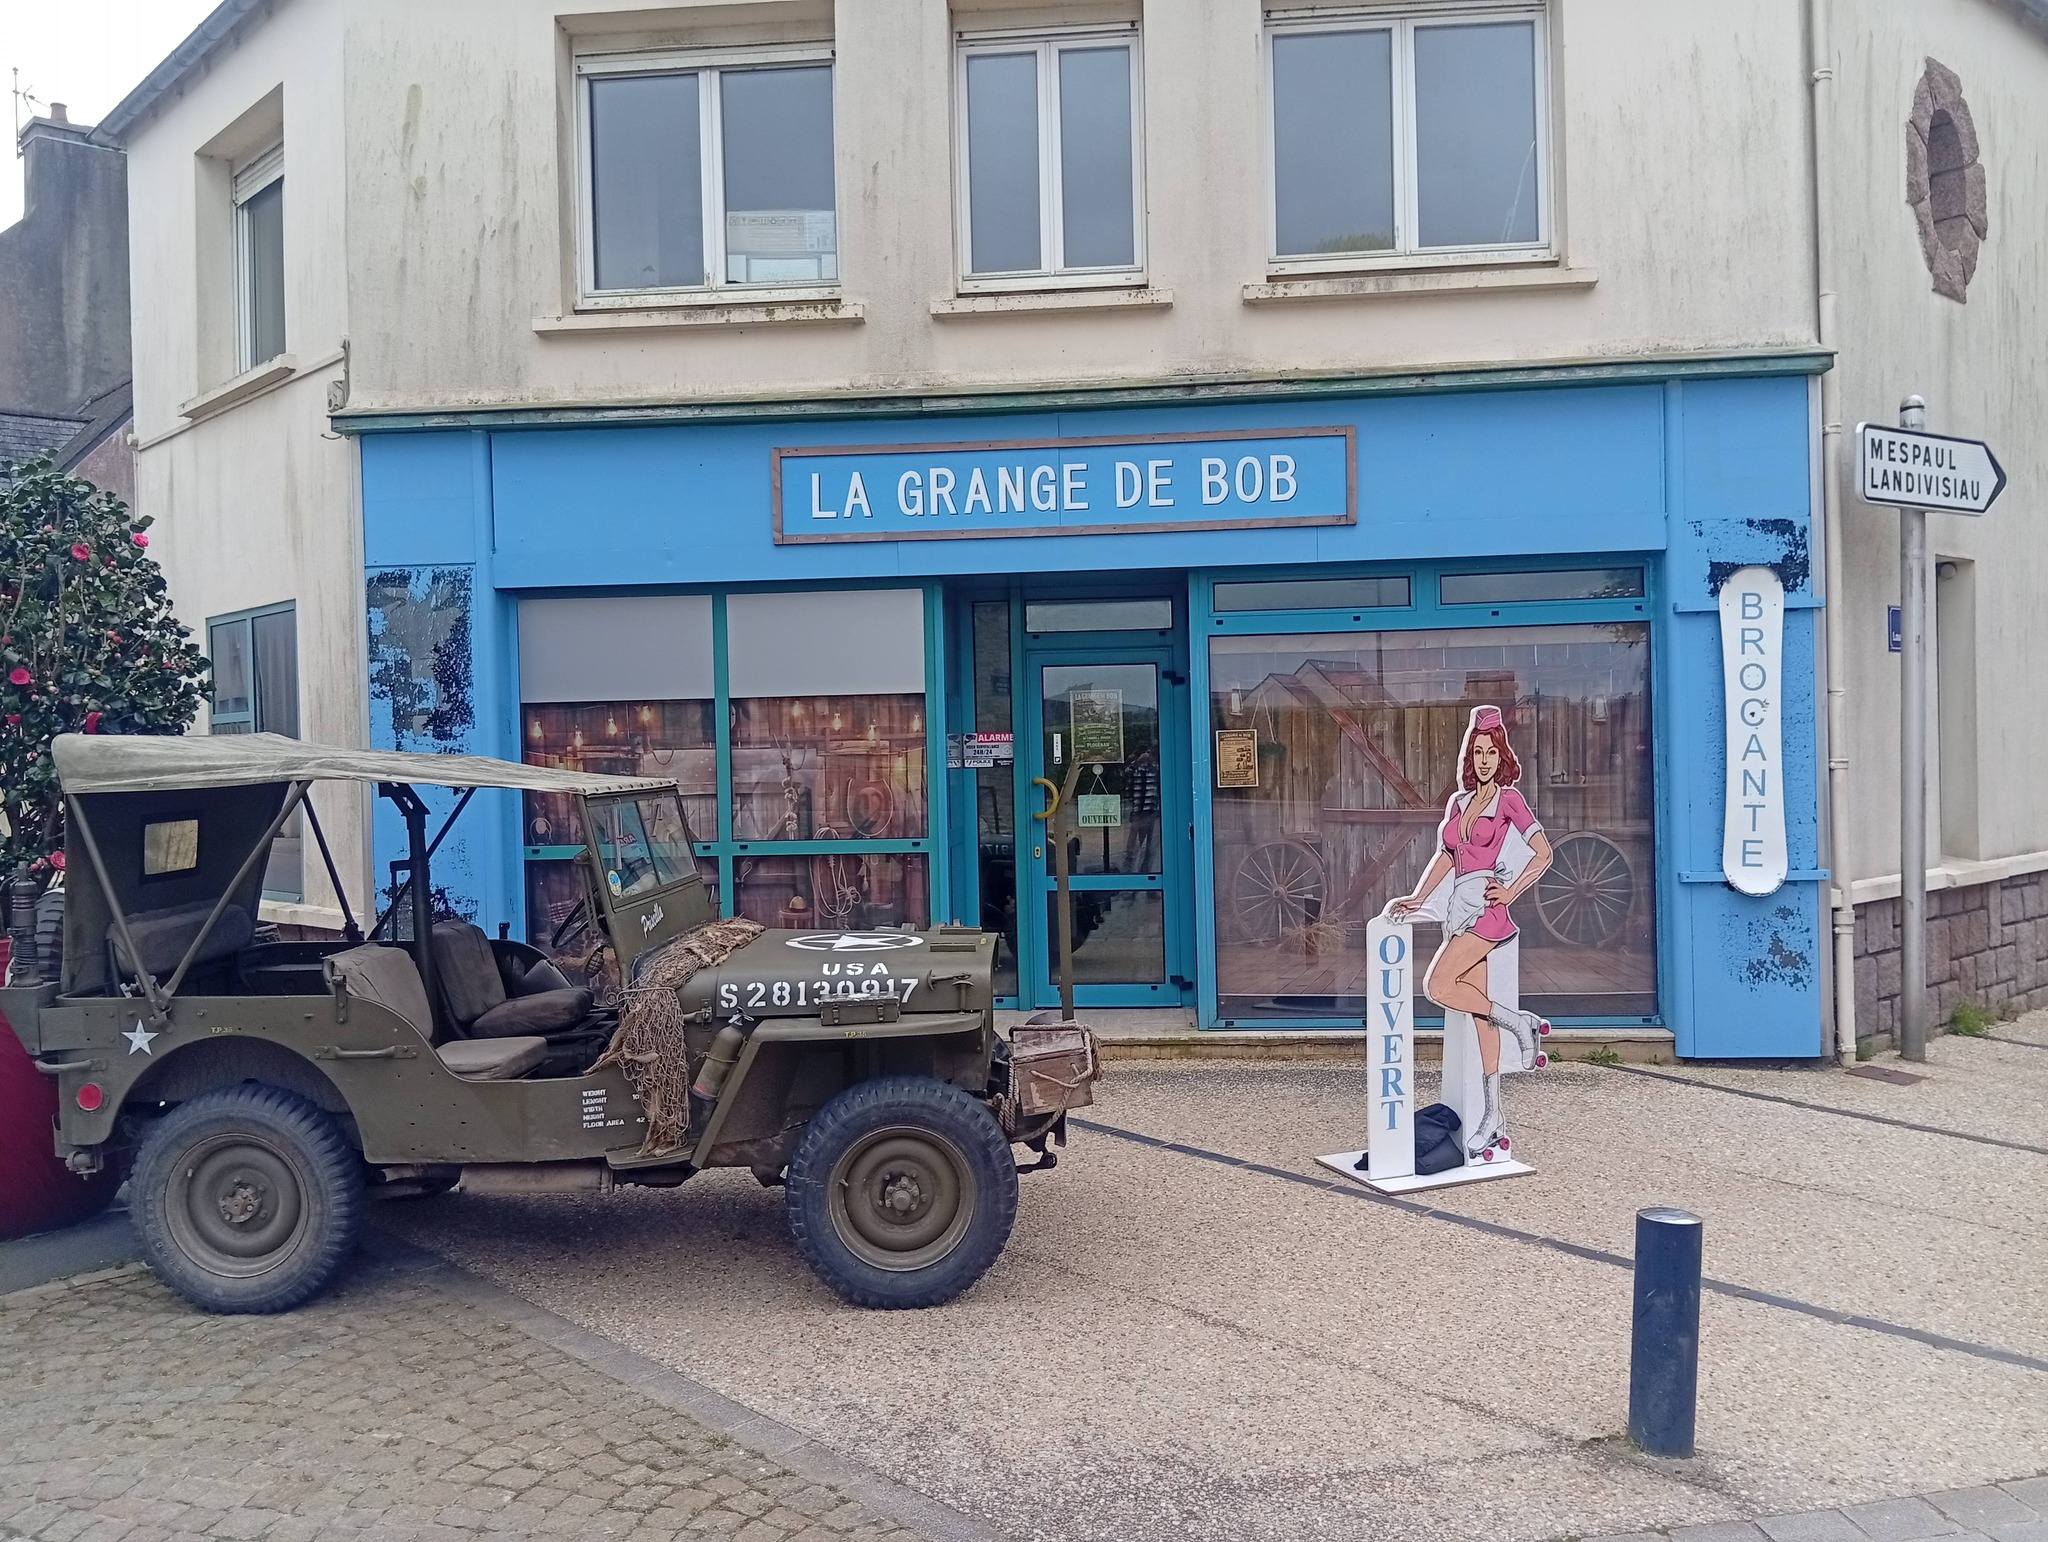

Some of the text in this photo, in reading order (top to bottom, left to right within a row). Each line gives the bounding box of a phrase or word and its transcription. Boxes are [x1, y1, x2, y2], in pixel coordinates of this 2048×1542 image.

[1870, 437, 1956, 470] MESPAUL
[811, 454, 1298, 518] LA GRANGE DE BOB
[1870, 466, 1980, 501] LANDIVISIAU
[1739, 592, 1767, 868] BROCANTE
[978, 733, 1013, 742] ALARME
[1082, 814, 1118, 824] OUVERTS
[822, 962, 890, 976] USA
[1379, 934, 1406, 1131] OUVERT
[582, 1089, 607, 1097] WEIGHT
[583, 1105, 603, 1113] WIDTH
[583, 1120, 604, 1129] FLOOR
[606, 1119, 625, 1127] AREA
